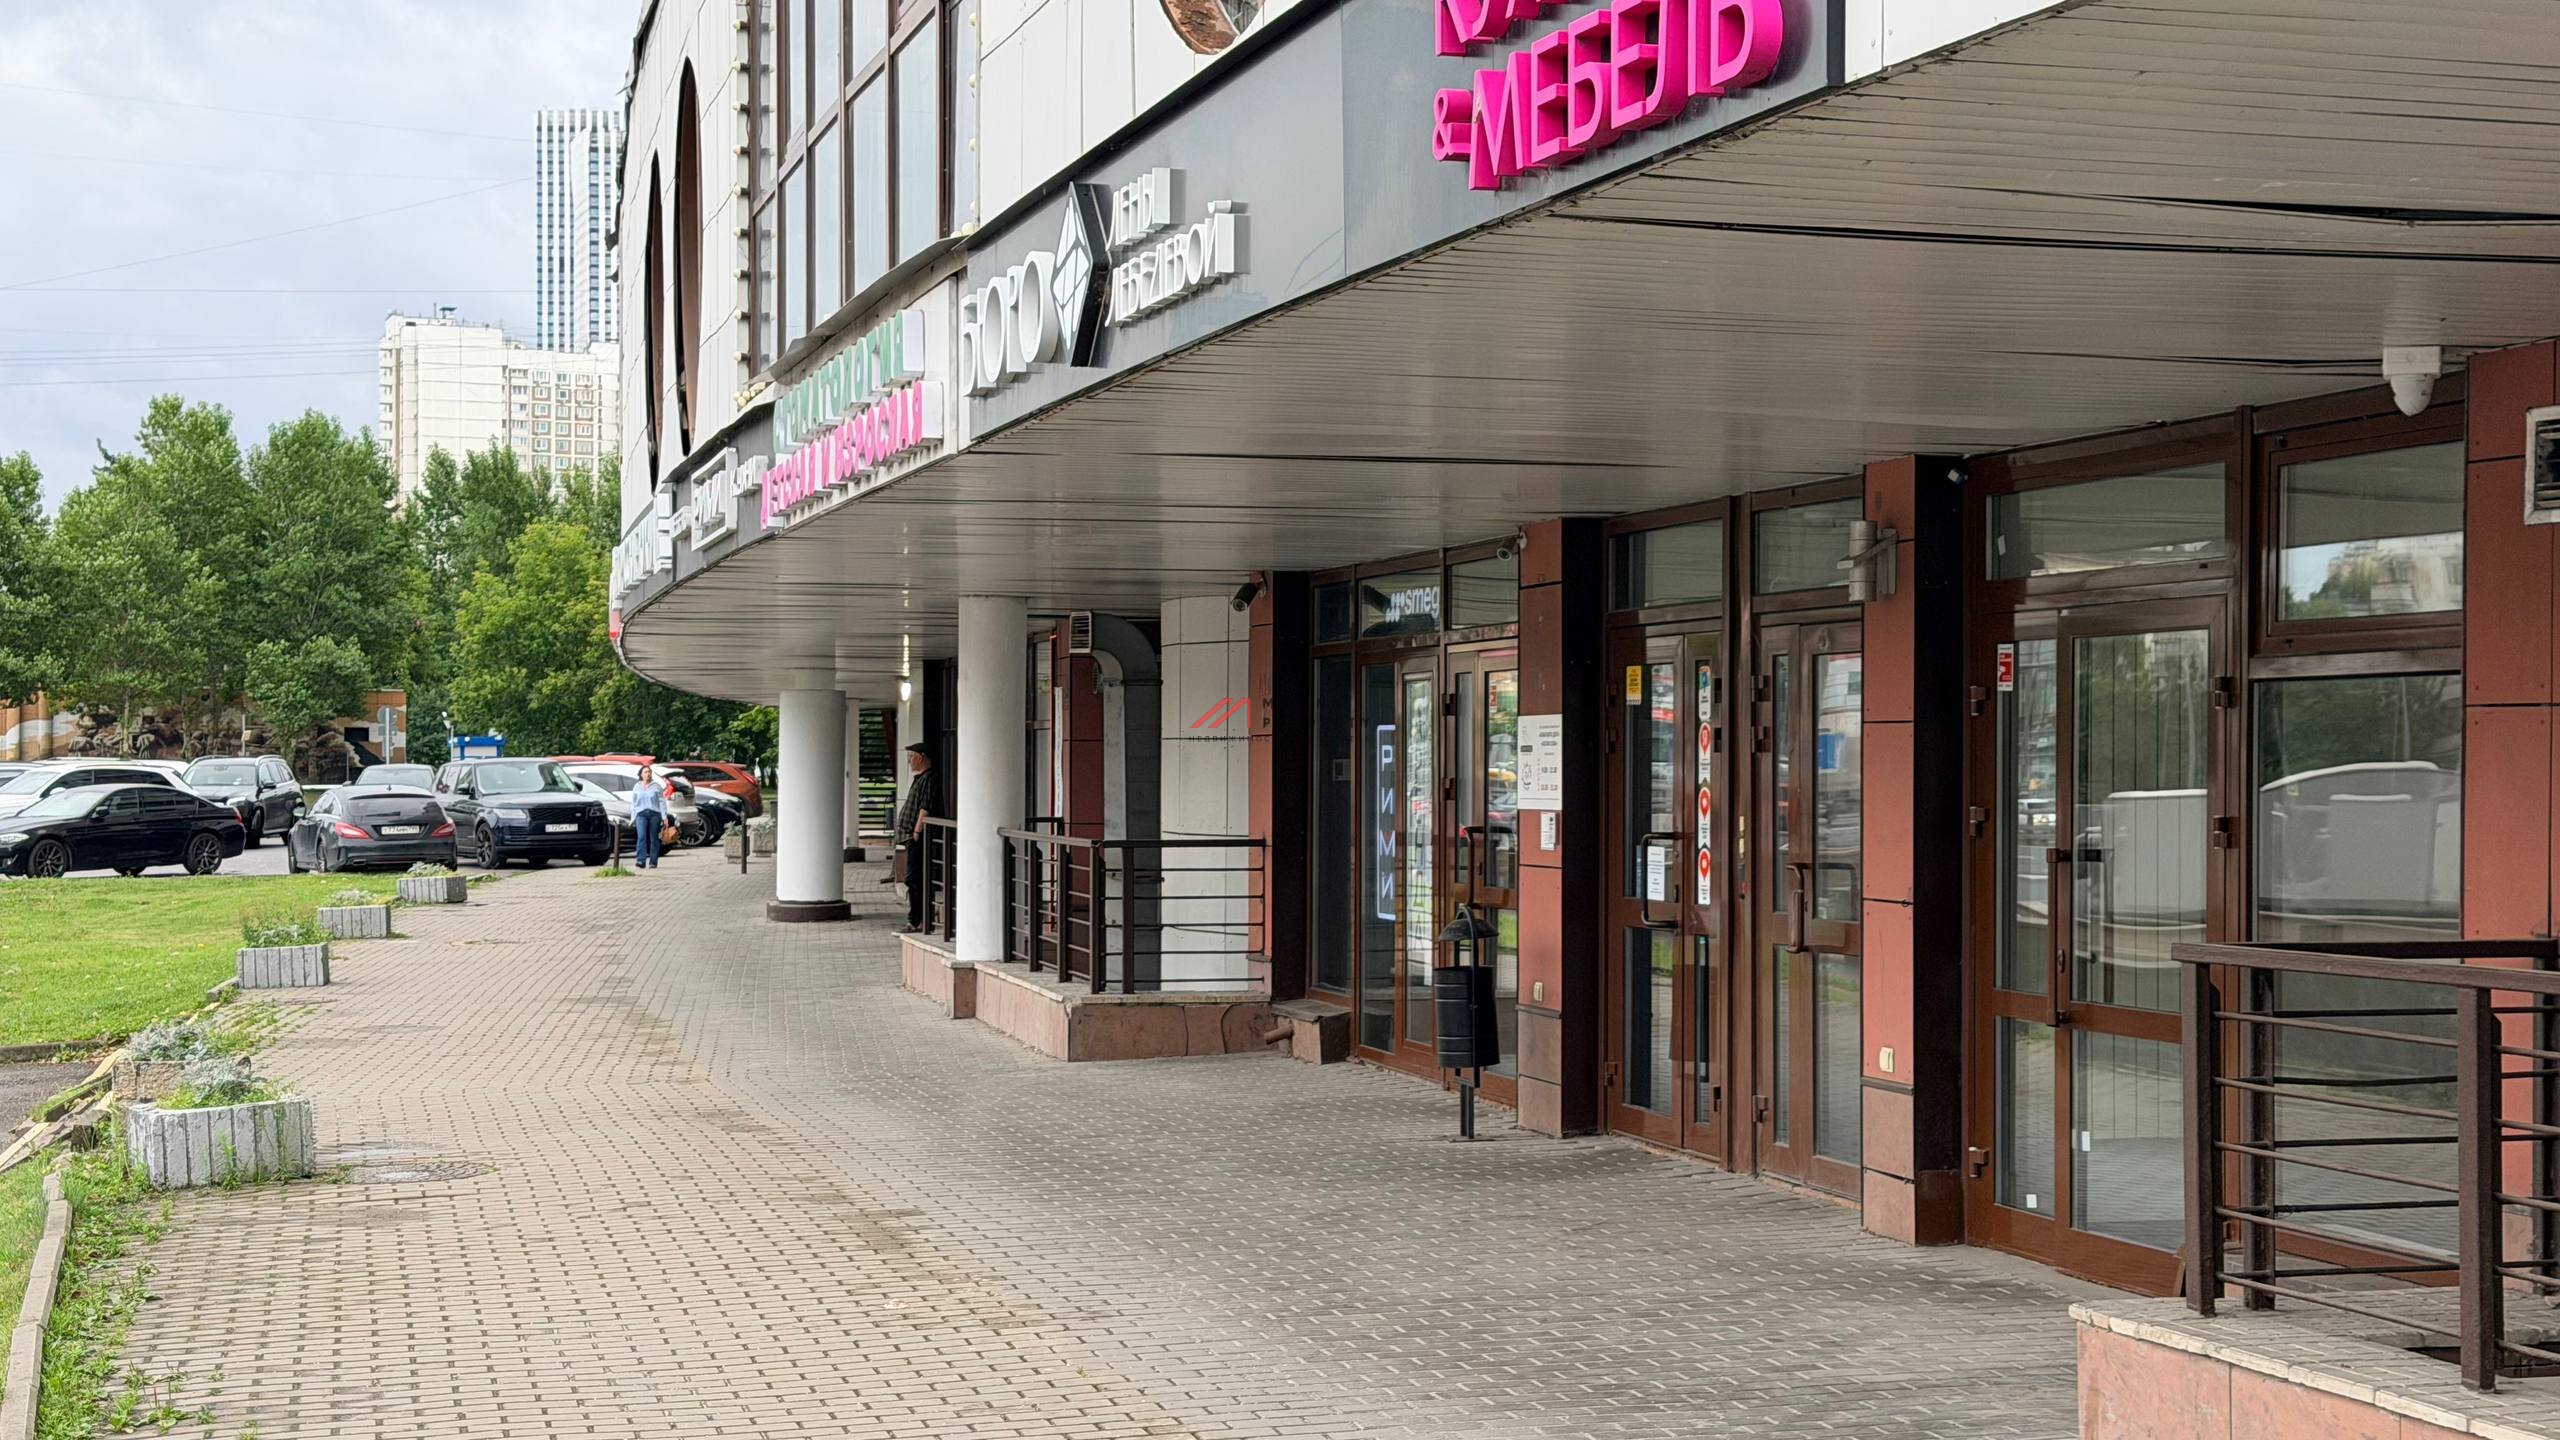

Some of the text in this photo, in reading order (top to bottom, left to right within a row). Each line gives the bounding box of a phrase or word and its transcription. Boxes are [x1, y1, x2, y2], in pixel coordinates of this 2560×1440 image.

[1105, 168, 1167, 251] ЛЕНЫ
[1105, 200, 1232, 328] ЛЕБЕДЕВОЙ
[773, 309, 908, 454] СТОМАТОЛОГИЯ
[961, 251, 1054, 396] БЮРО
[760, 441, 817, 531] ДЕТСКАЯ
[833, 380, 926, 482] ВЗРОСЛАЯ
[1404, 586, 1440, 619] smeg
[1380, 745, 1396, 899] РИМИ
